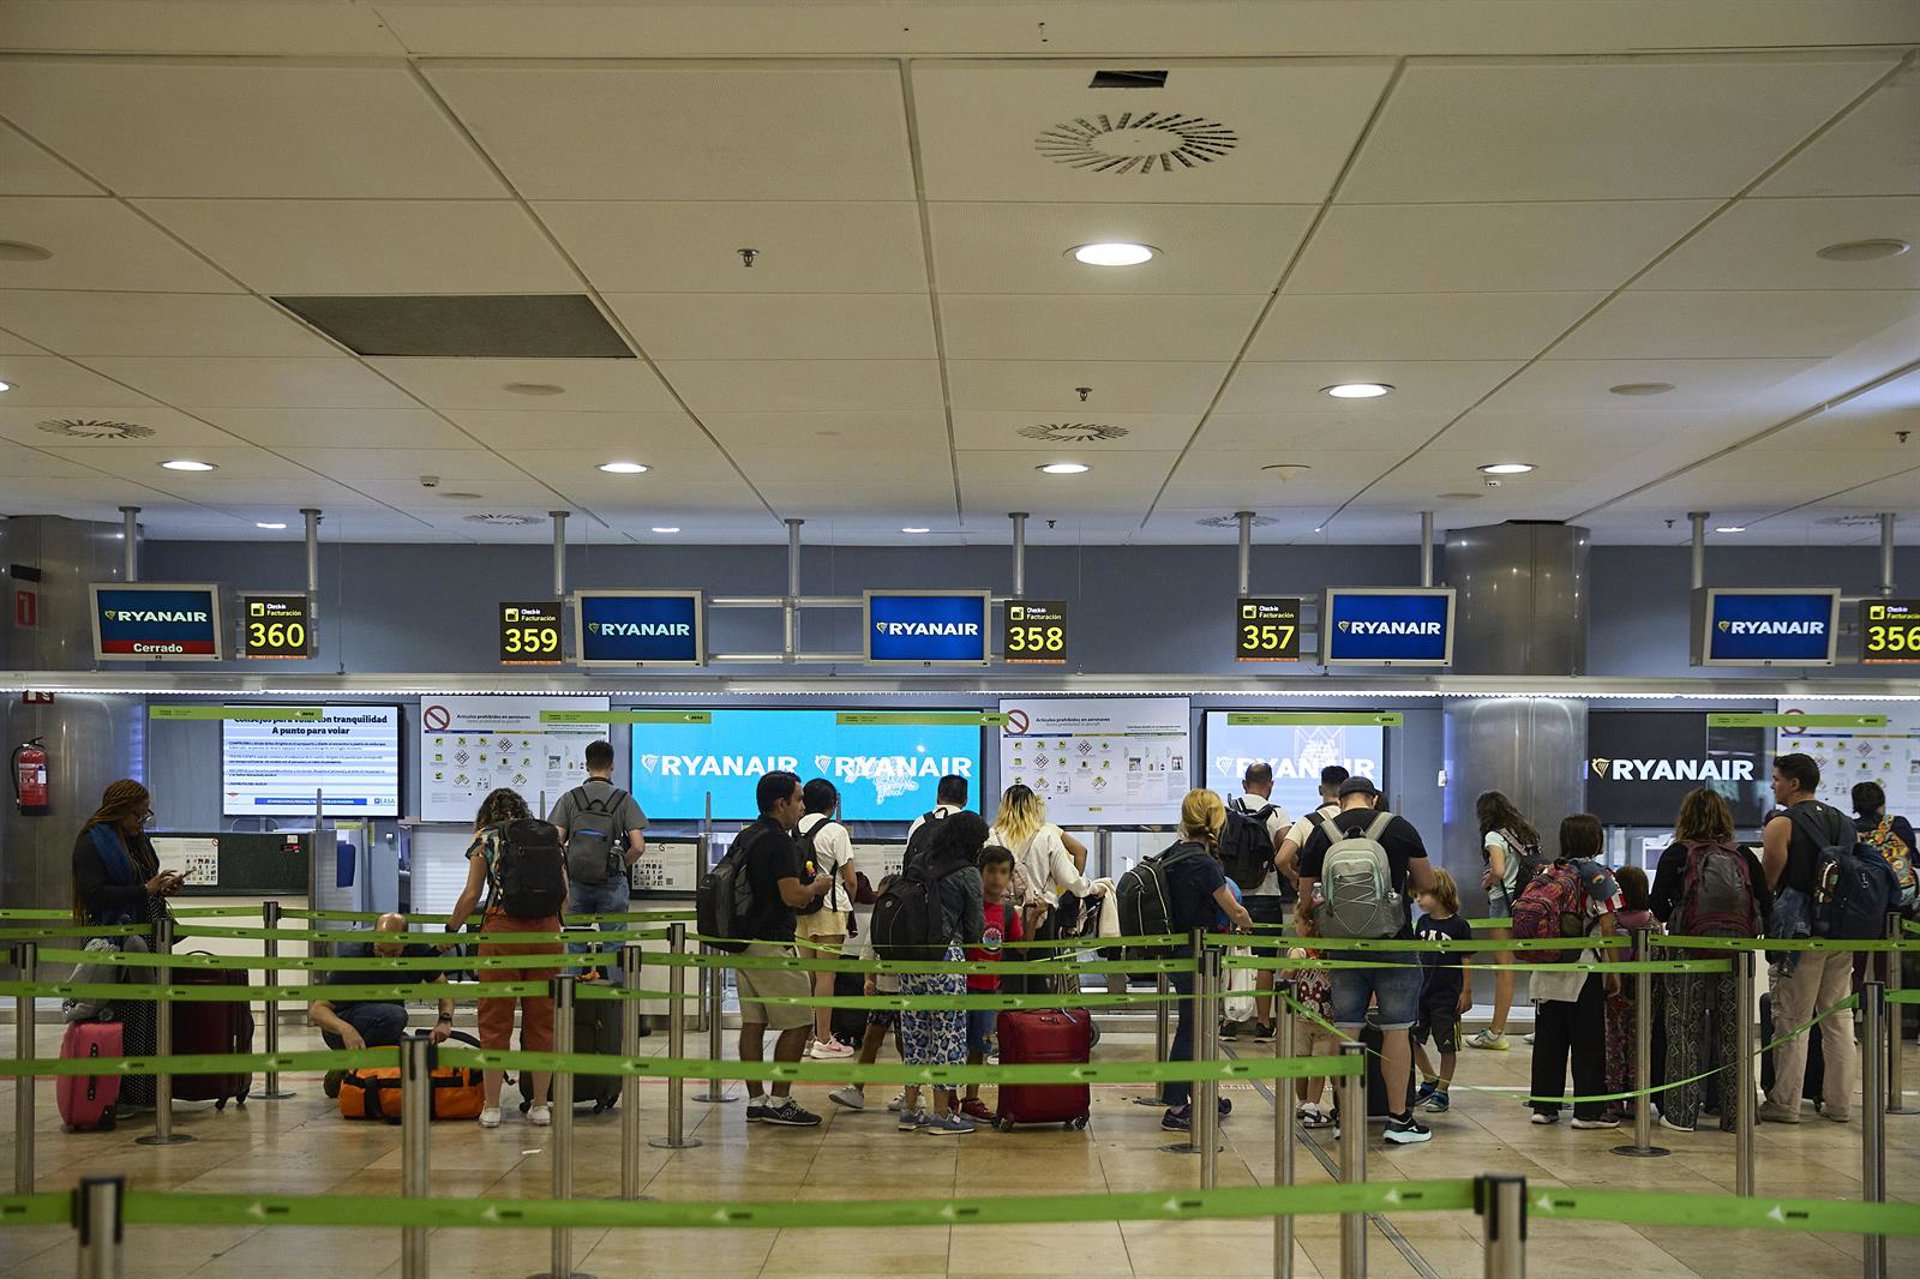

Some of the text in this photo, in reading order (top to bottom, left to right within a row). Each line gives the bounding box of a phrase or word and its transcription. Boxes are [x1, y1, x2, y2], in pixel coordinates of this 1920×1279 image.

[118, 611, 207, 622] RYANAIR
[249, 623, 305, 648] 360
[601, 623, 690, 636] RYANAIR
[889, 623, 979, 636] RYANAIR
[1351, 622, 1441, 635] RYANAIR
[1731, 621, 1825, 634] RYANAIR
[505, 628, 558, 653] 359
[1008, 626, 1064, 651] 358
[1242, 625, 1295, 650] 357
[1867, 626, 1920, 651] 356
[133, 643, 183, 653] Cerrado
[333, 714, 388, 725] tranquilidad
[280, 727, 306, 736] punto
[306, 728, 327, 736] para
[662, 755, 798, 776] RYANAIR
[835, 756, 972, 777] RYANAIR
[1612, 759, 1754, 781] RYANAIR
